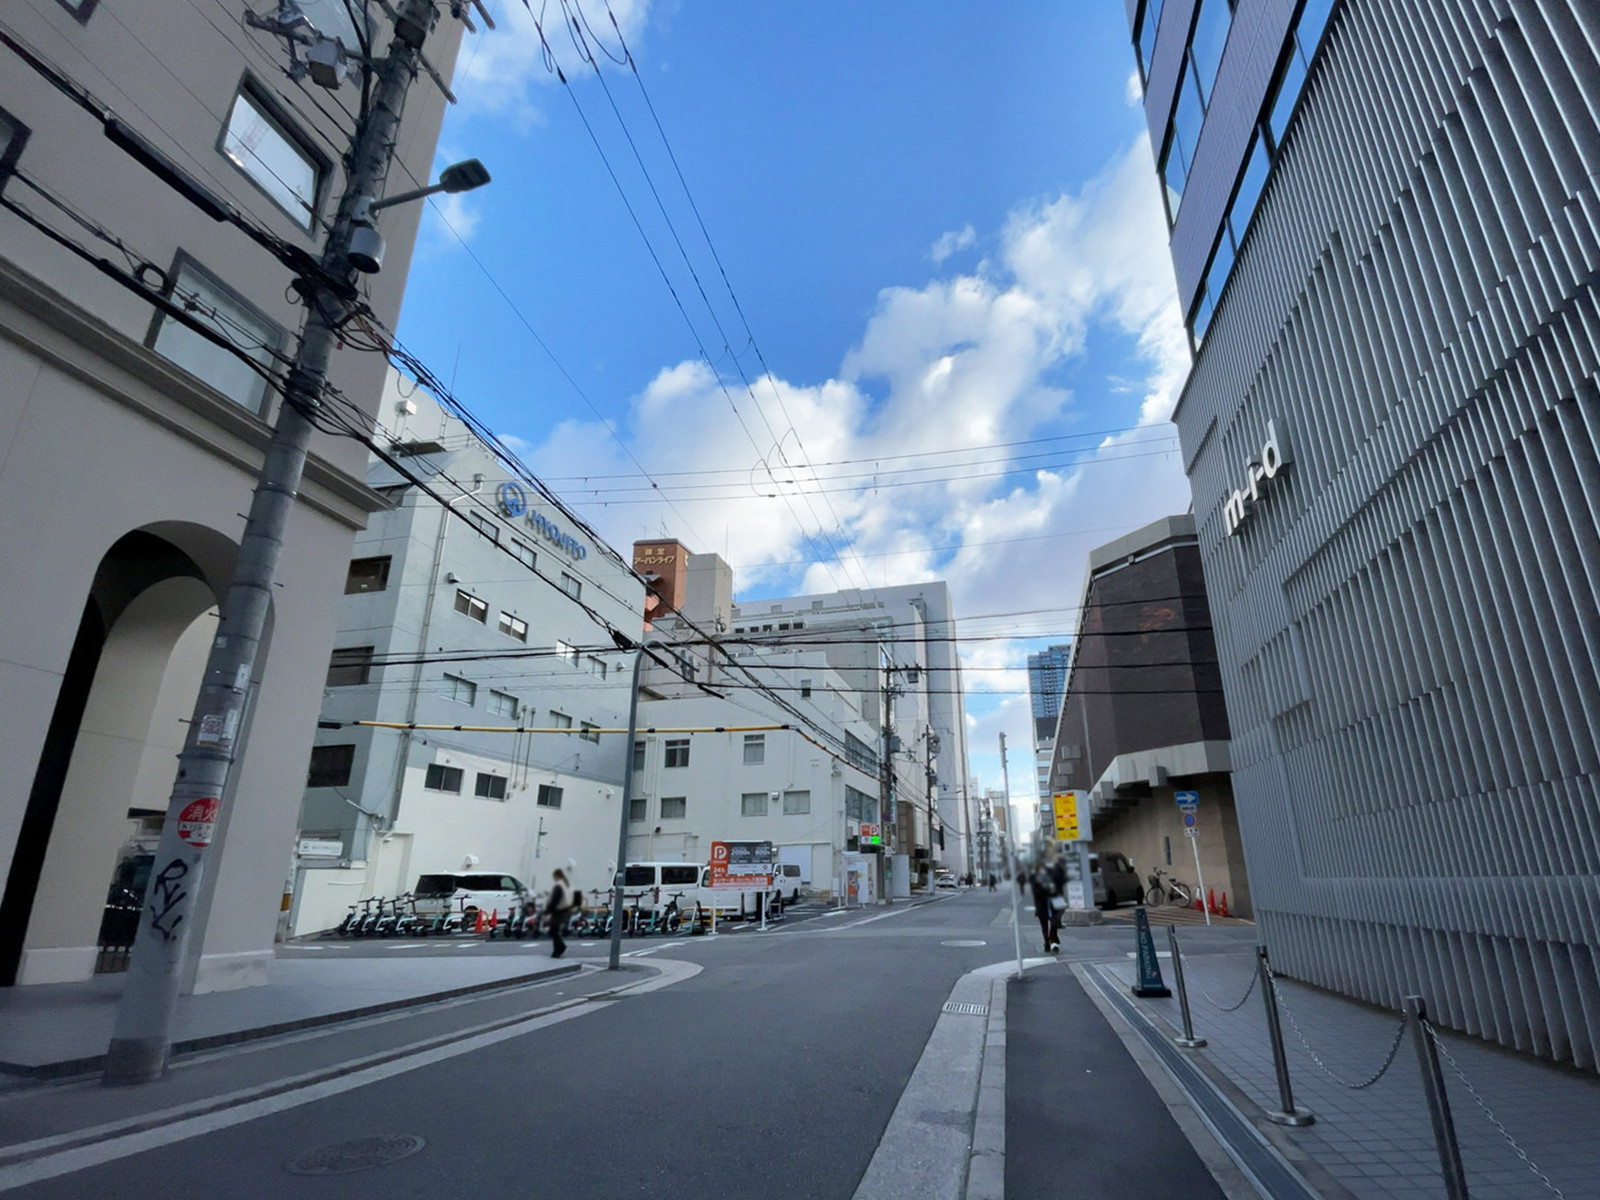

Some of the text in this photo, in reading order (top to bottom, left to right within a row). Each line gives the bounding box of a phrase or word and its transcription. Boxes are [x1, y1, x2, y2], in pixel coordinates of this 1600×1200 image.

[1223, 418, 1282, 537] m-i-d
[634, 555, 675, 565] アーバンライフ
